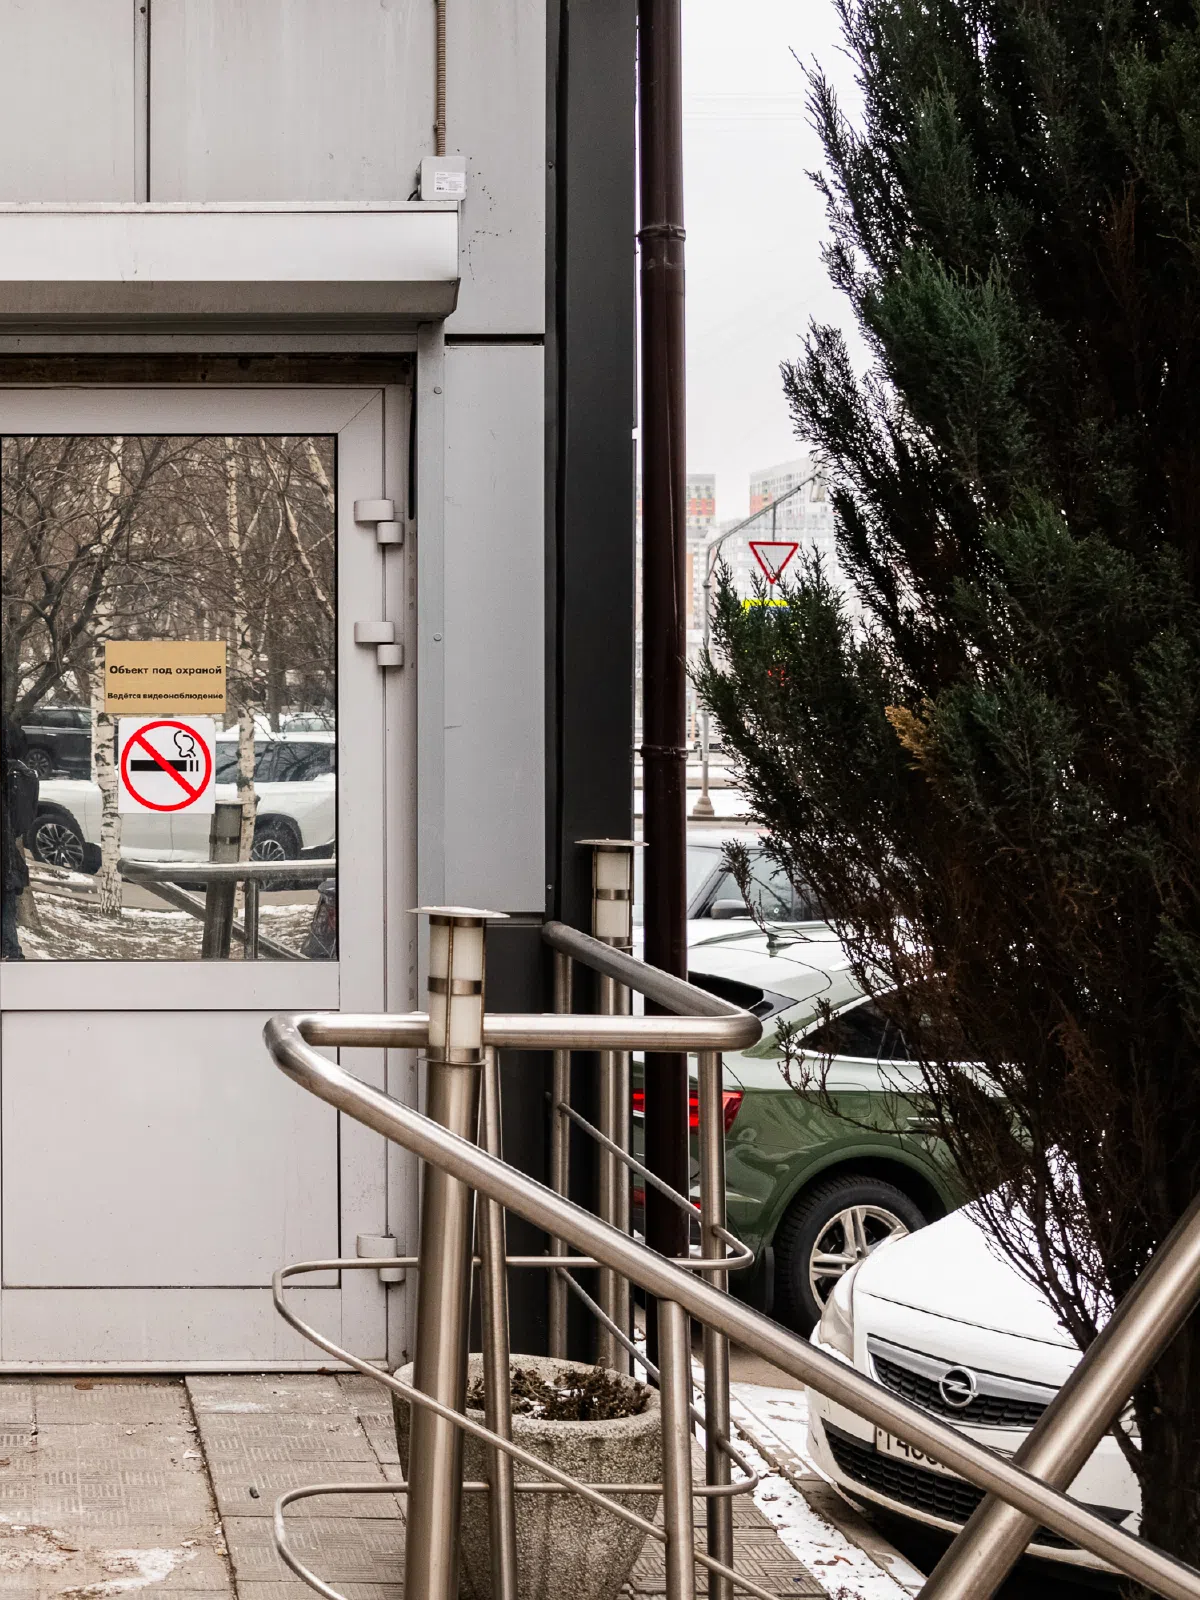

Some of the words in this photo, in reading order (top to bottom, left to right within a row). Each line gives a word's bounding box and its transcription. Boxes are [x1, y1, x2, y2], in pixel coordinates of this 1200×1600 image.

[109, 665, 149, 675] Объект
[152, 667, 173, 675] под
[175, 665, 222, 676] охраной
[107, 692, 141, 700] Ведётся
[142, 692, 224, 700] видеонаблюдение
